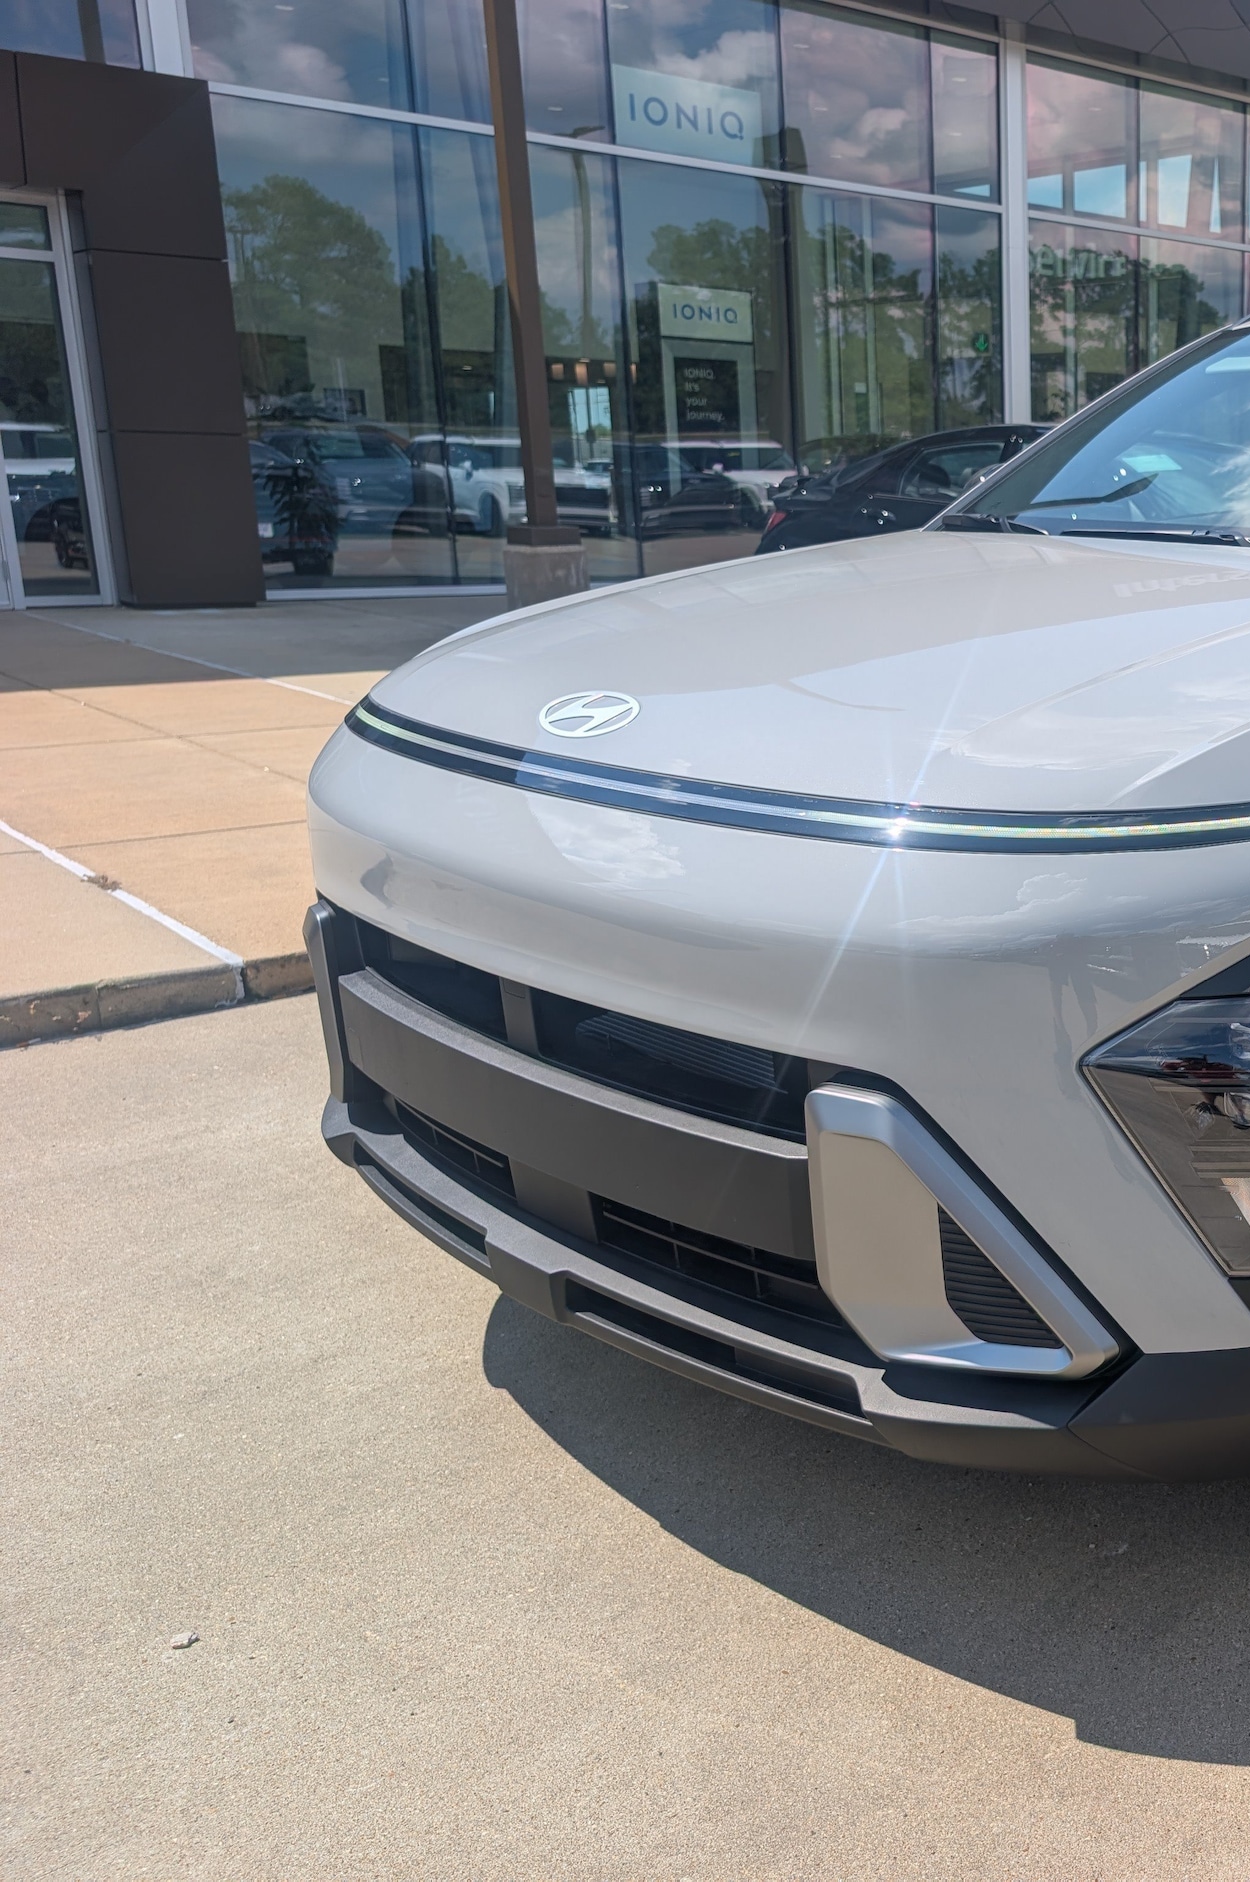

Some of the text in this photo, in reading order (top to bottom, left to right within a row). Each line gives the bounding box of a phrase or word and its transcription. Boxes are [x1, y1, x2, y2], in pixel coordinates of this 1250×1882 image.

[628, 92, 745, 141] IONIQ
[672, 303, 738, 324] IONIQ
[685, 396, 708, 407] your
